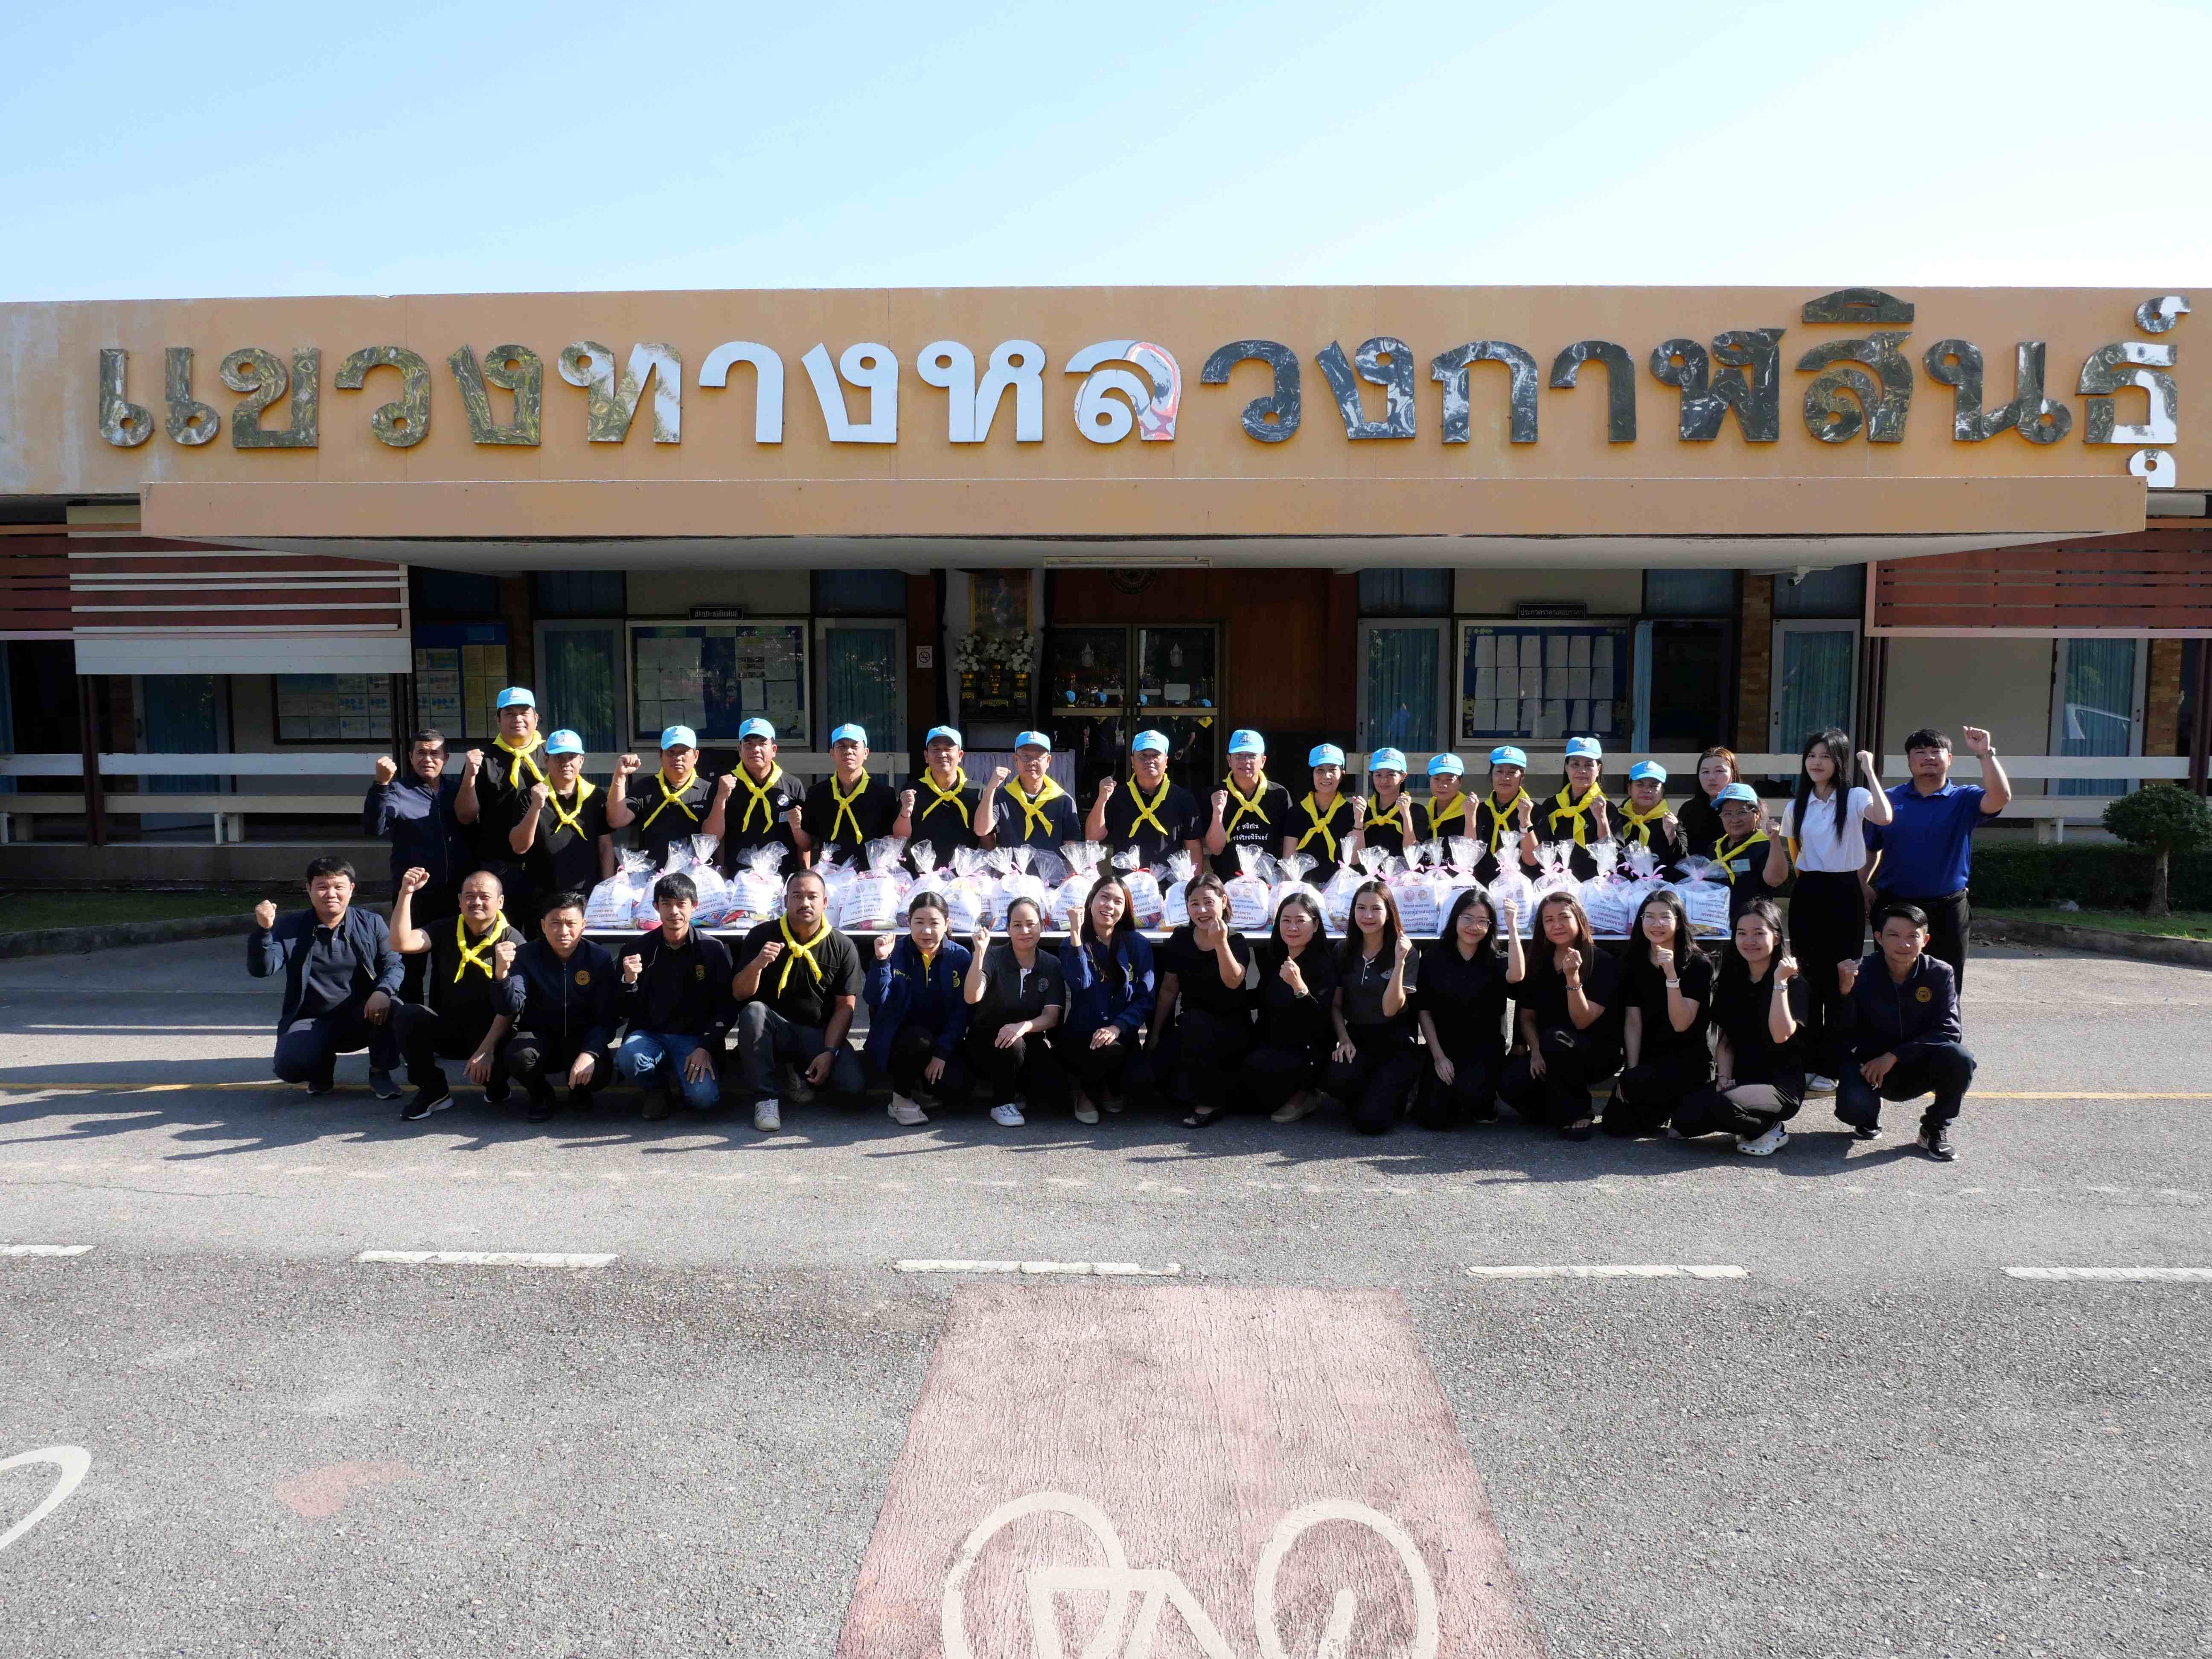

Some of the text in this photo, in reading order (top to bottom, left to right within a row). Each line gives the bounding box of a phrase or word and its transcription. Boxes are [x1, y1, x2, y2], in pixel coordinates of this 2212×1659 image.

[98, 288, 2190, 487] แขวงทางหลวงกาฬสินธุ์
